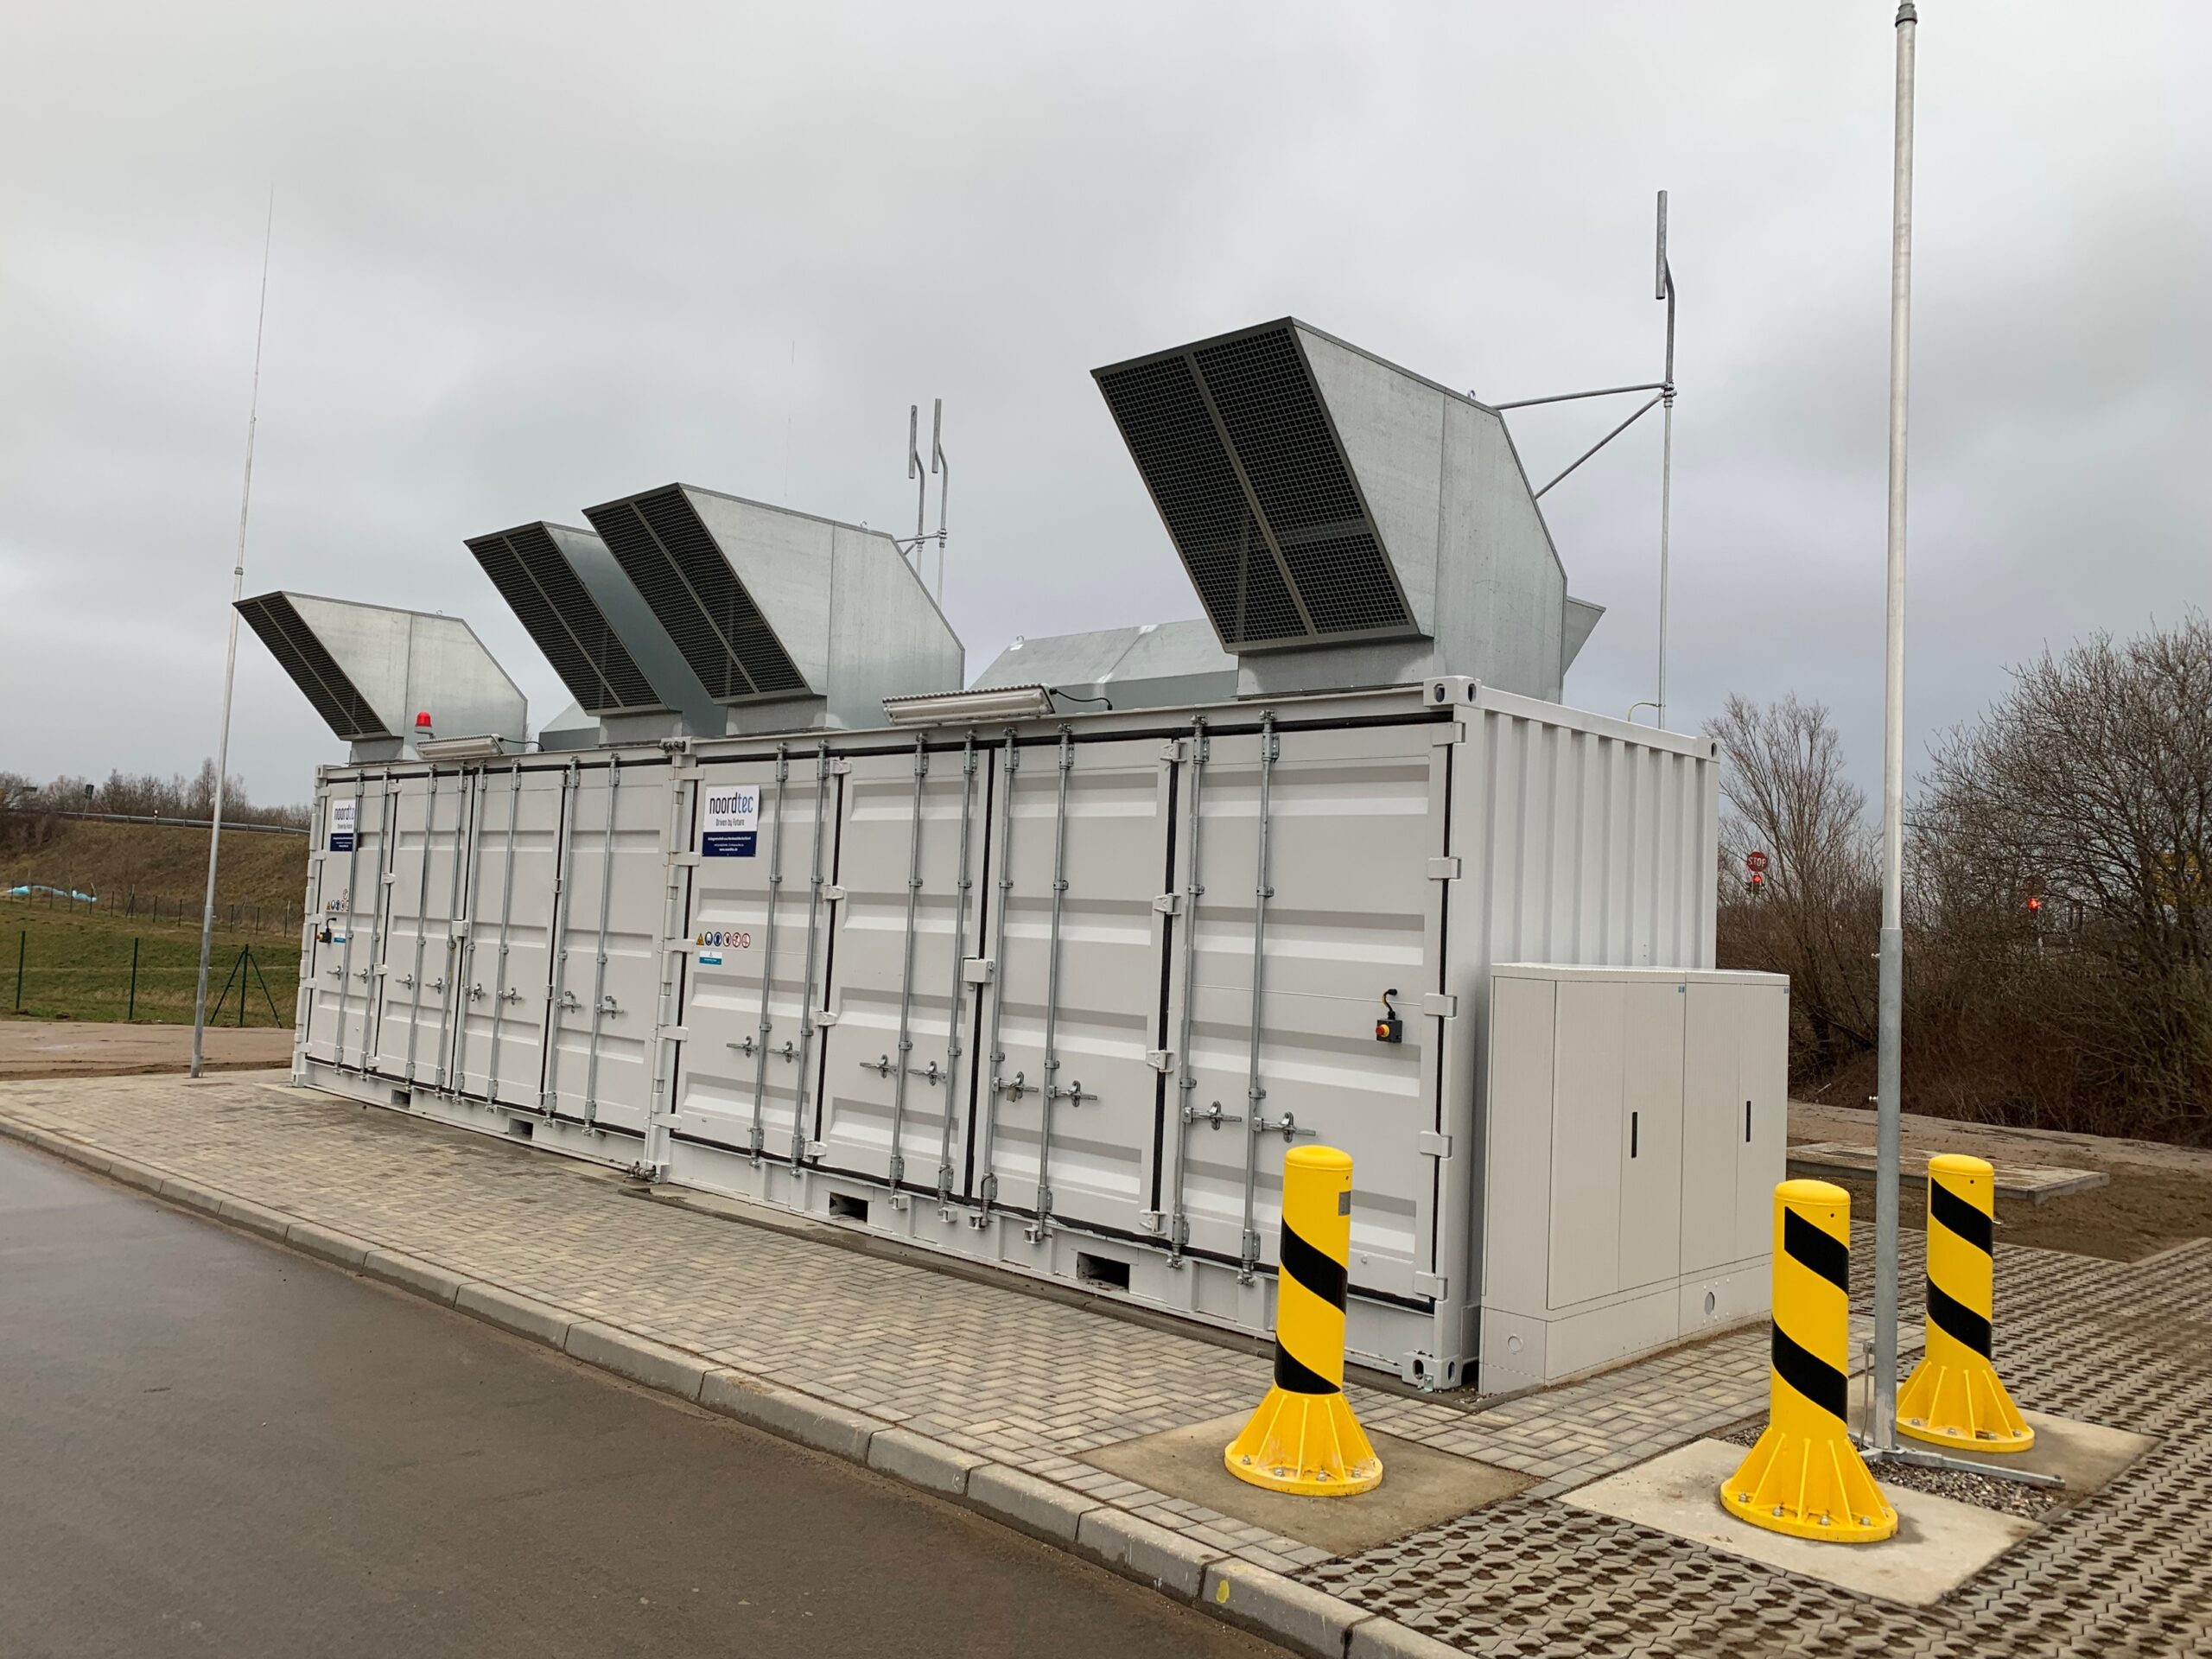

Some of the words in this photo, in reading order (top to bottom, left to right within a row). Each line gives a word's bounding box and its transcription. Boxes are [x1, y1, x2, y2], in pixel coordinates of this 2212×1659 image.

[709, 791, 753, 814] noordtec
[334, 804, 355, 820] noordte
[1748, 856, 1766, 867] STOP
